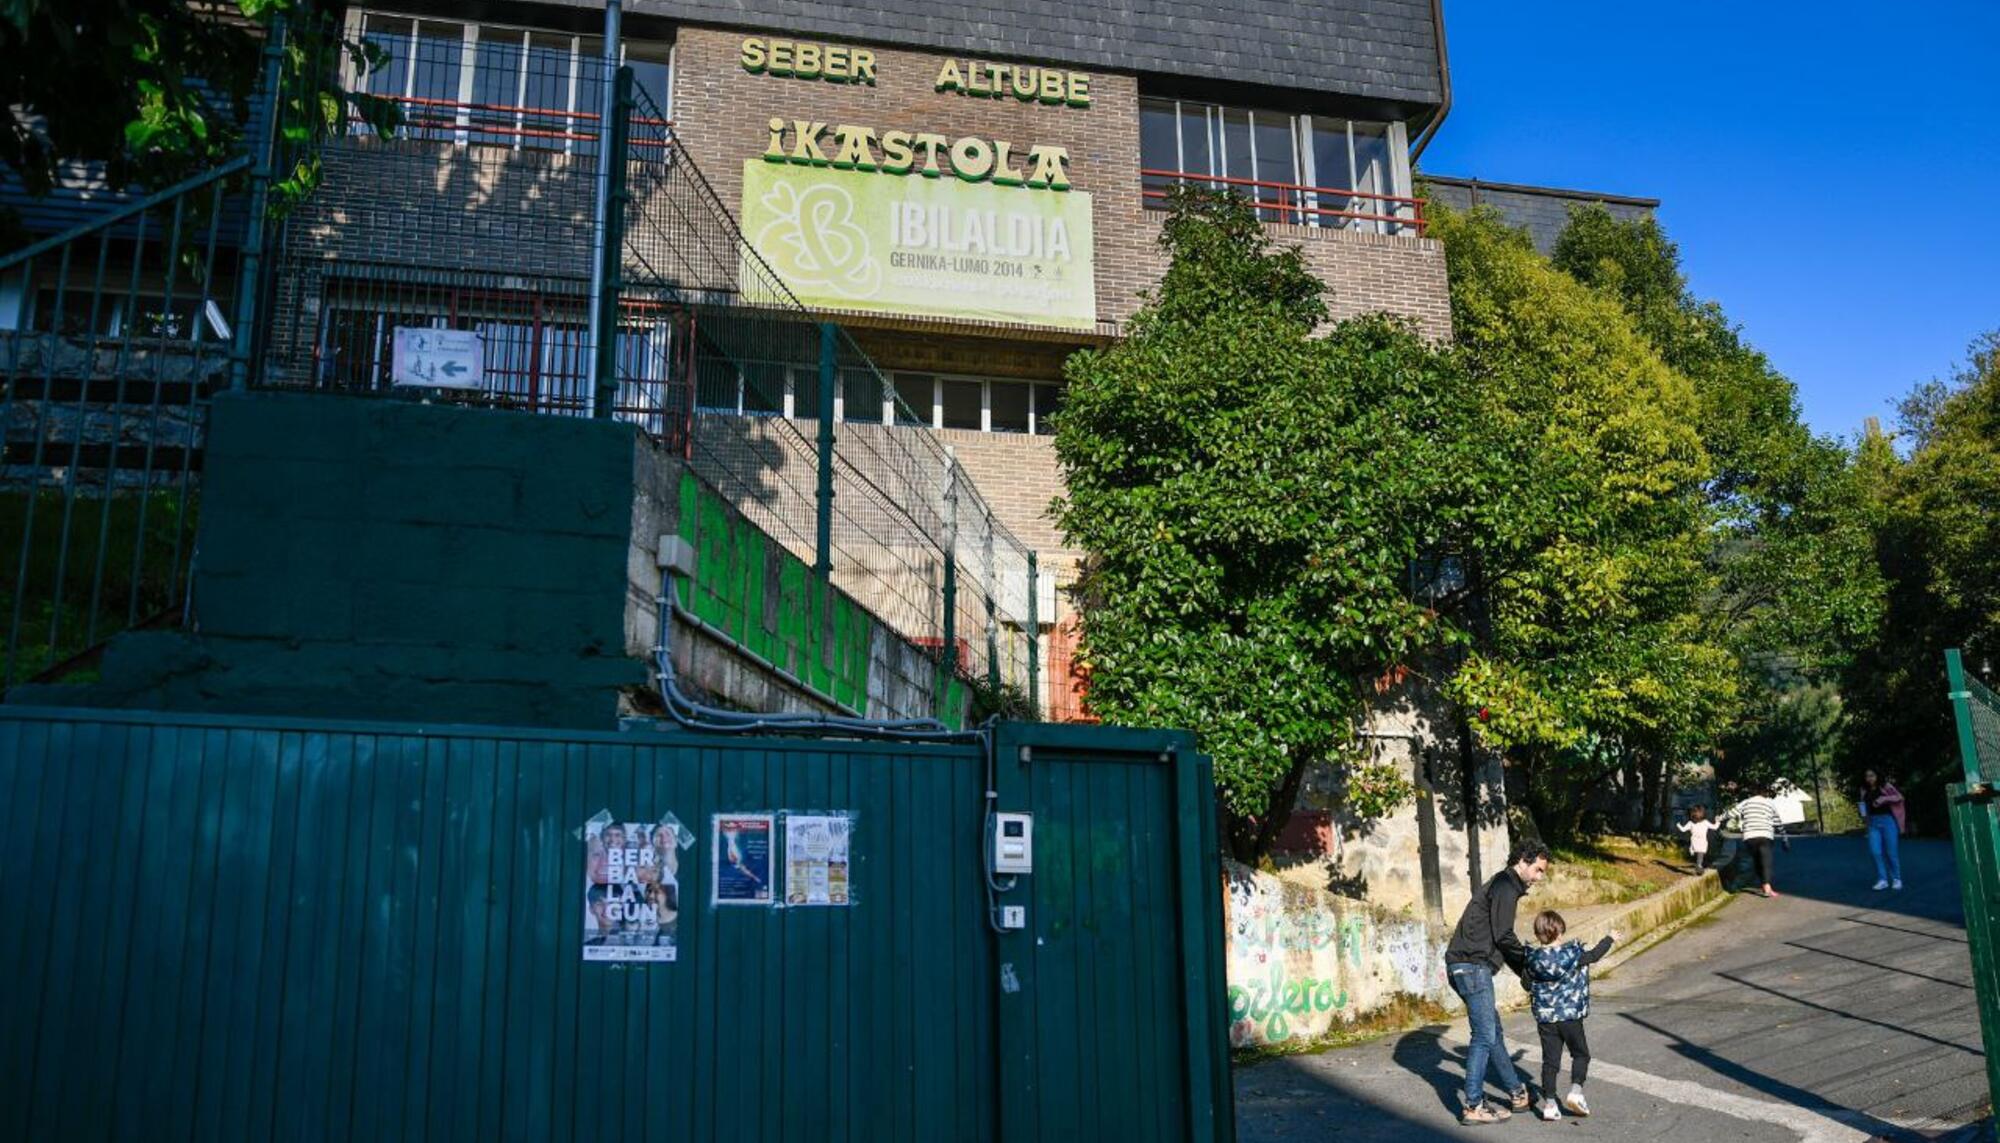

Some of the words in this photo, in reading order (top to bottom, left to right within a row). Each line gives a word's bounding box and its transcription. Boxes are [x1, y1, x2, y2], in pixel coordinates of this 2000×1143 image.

[741, 38, 876, 85] SEBER
[935, 59, 1091, 107] ALTUBE
[890, 201, 1071, 261] IBILALDIA
[890, 251, 989, 275] GERNIKA-LUMO
[993, 260, 1023, 278] 2014
[608, 848, 655, 866] BER
[608, 866, 639, 884] BA
[606, 884, 636, 902] LA
[605, 903, 658, 922] GUN
